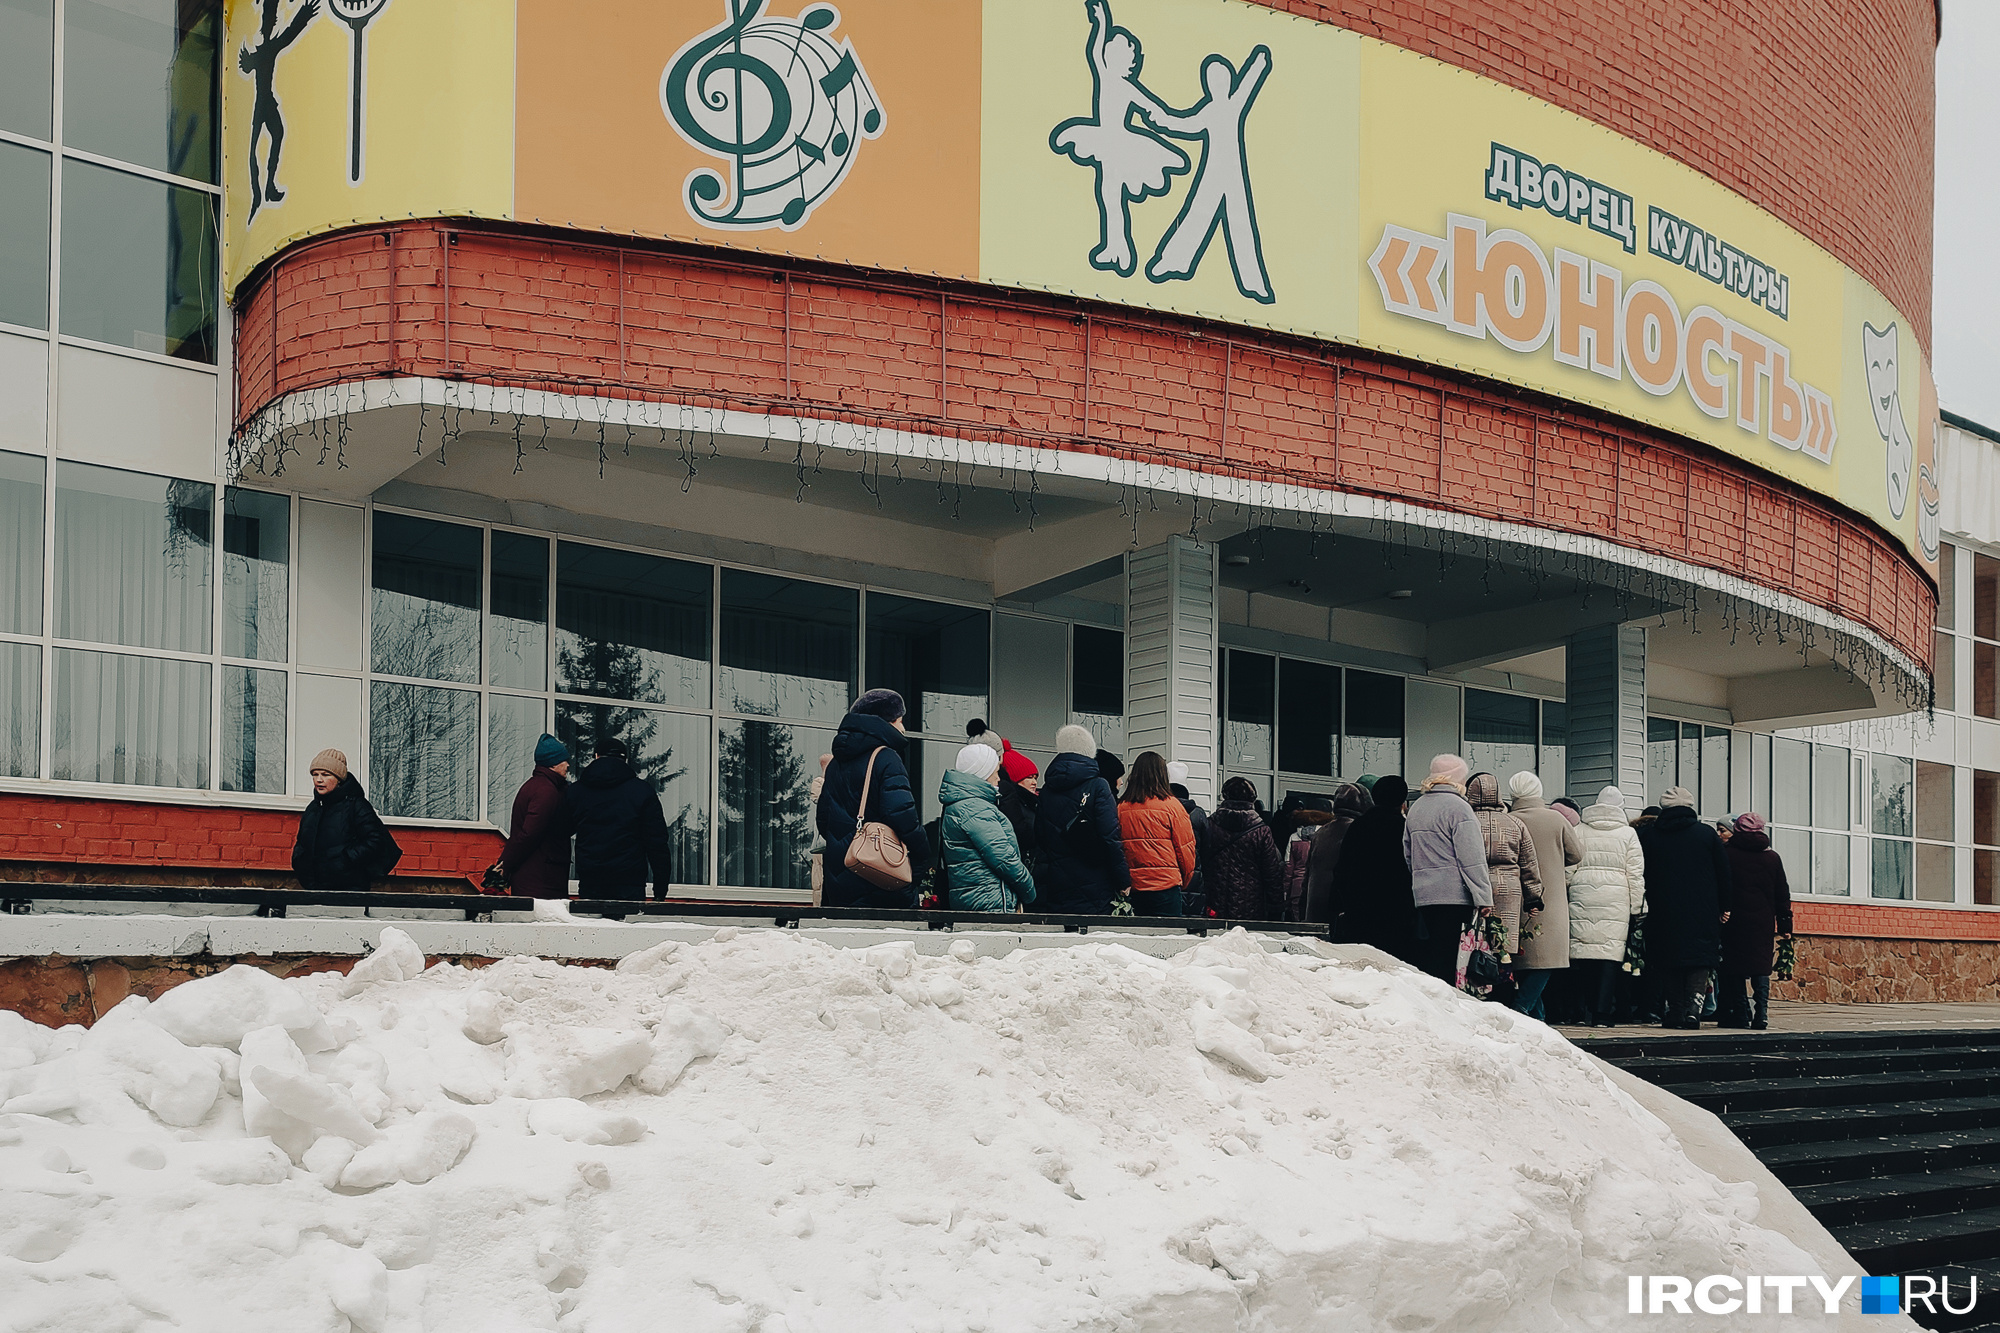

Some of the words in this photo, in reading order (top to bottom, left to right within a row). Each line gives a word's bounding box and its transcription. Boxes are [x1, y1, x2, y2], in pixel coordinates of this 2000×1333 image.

[1488, 146, 1635, 251] ДВОРЕЦ
[1651, 209, 1788, 318] КУЛЬТУРЫ
[1368, 213, 1838, 464] «ЮНОСТЬ»
